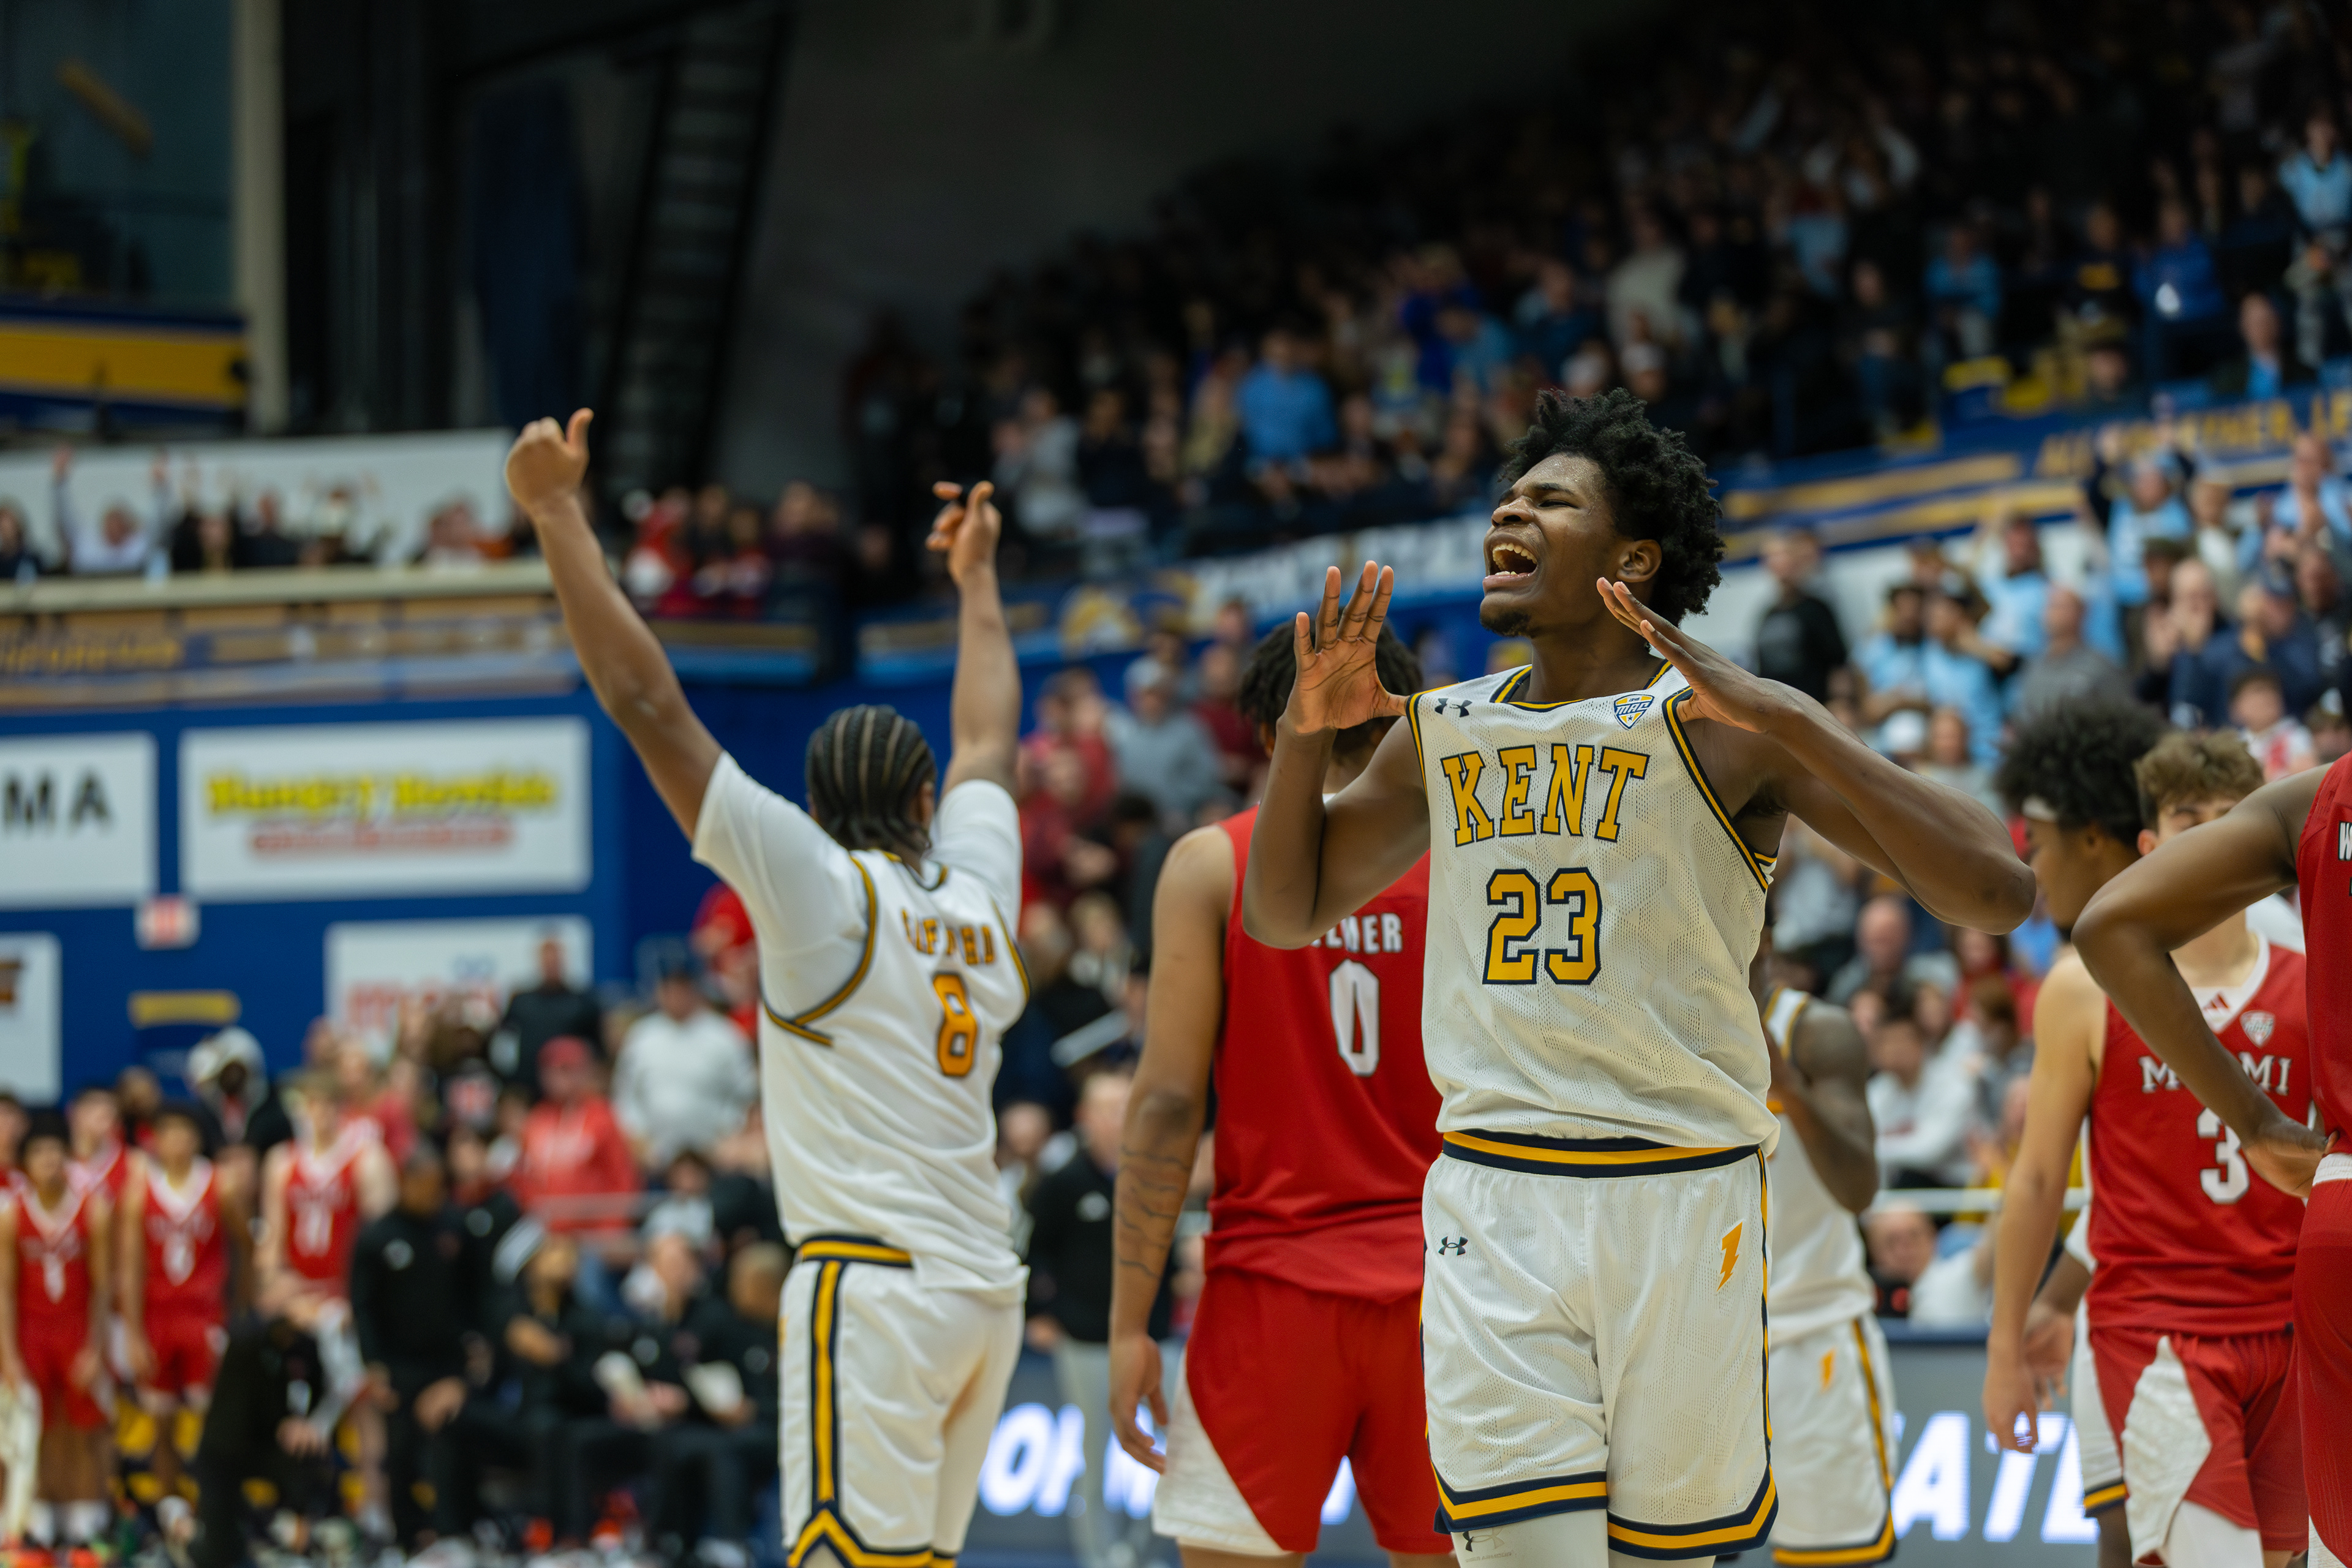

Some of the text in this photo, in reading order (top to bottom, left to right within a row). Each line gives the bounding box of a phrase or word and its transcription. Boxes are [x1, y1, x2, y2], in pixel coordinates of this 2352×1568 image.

[1617, 702, 1650, 714] MAC
[1440, 743, 1651, 847] KENT
[1310, 912, 1403, 954] LMER
[1482, 867, 1603, 985] 23
[930, 971, 978, 1077] 8
[1328, 957, 1380, 1077] 0
[2137, 1050, 2293, 1096] MMI
[2196, 1106, 2250, 1205] 3
